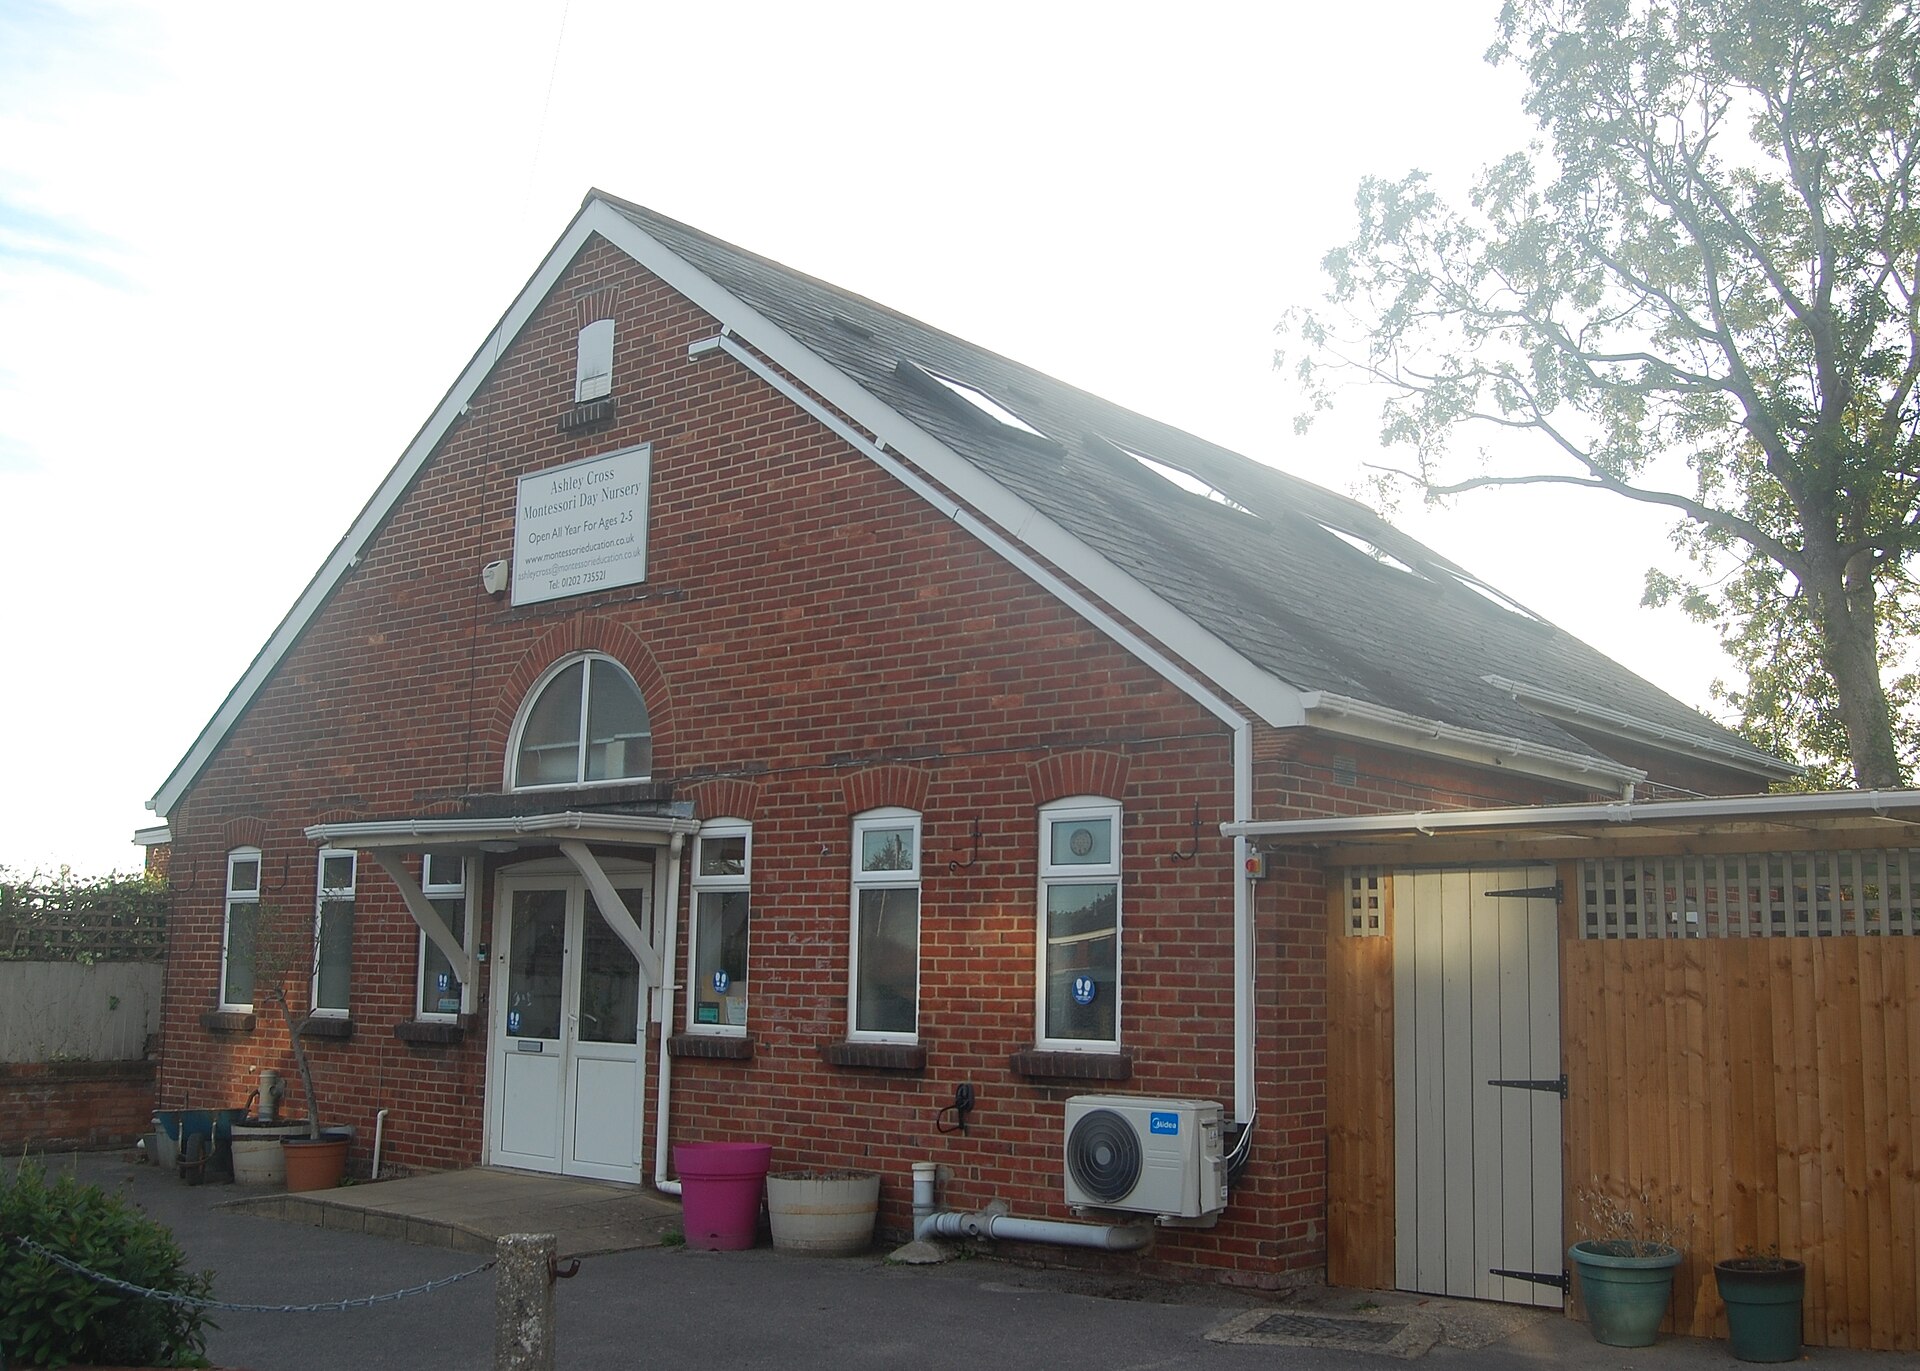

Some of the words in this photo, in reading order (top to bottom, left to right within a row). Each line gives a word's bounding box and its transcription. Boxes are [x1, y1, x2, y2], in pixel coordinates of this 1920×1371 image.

[551, 476, 584, 495] Ashley
[587, 469, 615, 485] Cross
[524, 495, 576, 520] Montessori
[580, 493, 598, 507] Day
[602, 482, 641, 502] Nursery
[528, 532, 550, 545] Open
[552, 528, 563, 539] All
[565, 525, 581, 536] Year
[584, 521, 597, 532] For
[599, 517, 617, 530] Ages
[621, 510, 633, 523] 2-5
[518, 547, 641, 580] ashleycross@montessorieducation.co.uk
[525, 533, 635, 564] www.montessorieducation.co.uk
[549, 580, 560, 590] Tel:
[562, 576, 581, 588] 01202
[583, 570, 606, 583] 735521
[1152, 1117, 1177, 1129] Midea
